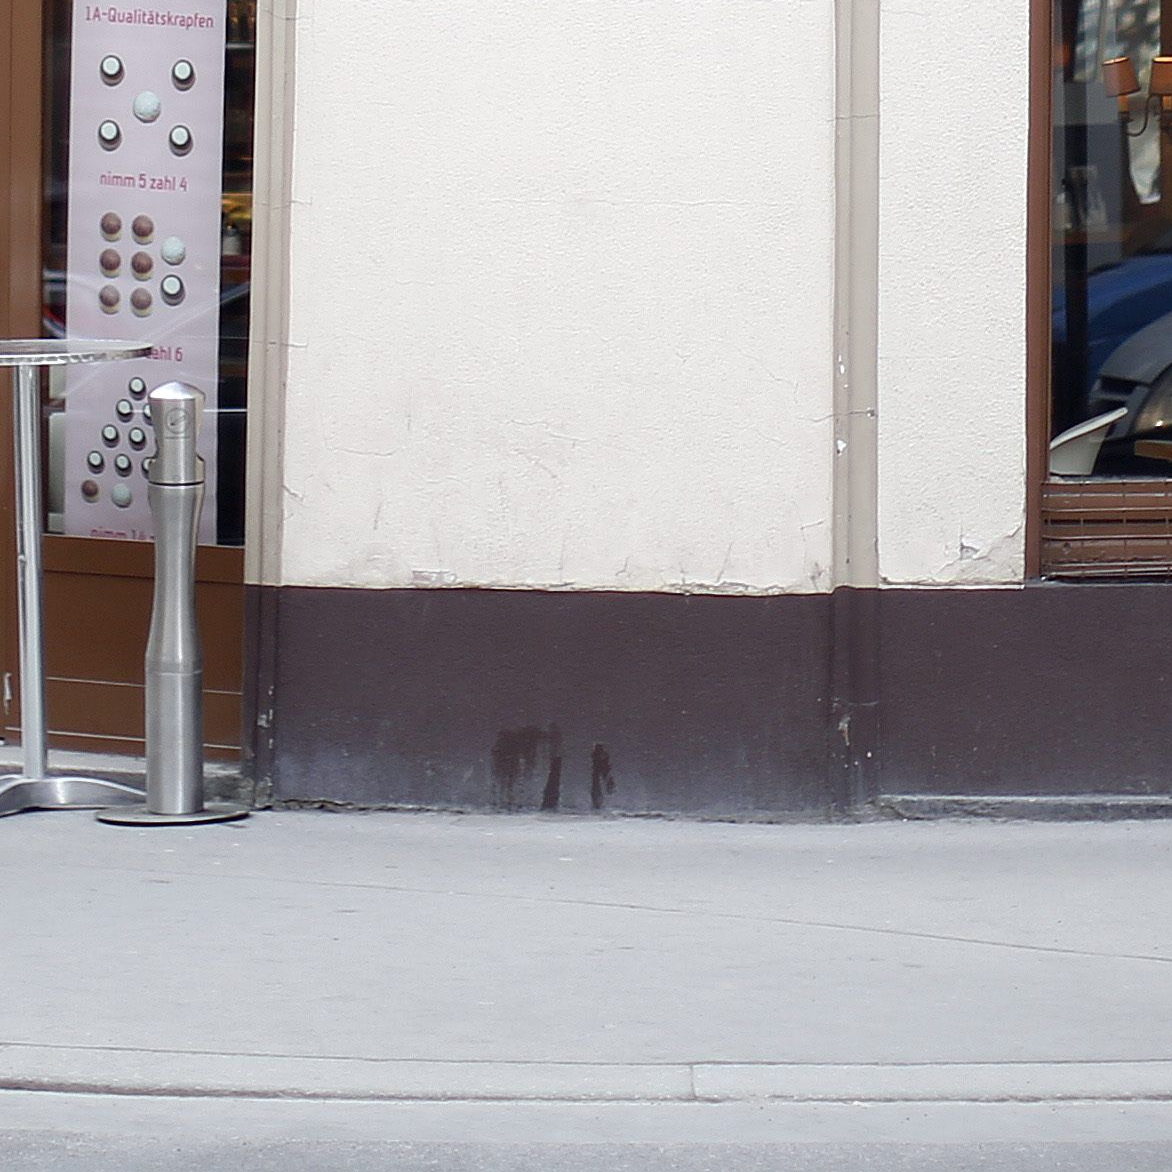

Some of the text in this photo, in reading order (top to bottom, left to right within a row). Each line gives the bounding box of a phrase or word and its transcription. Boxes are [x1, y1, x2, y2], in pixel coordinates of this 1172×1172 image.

[86, 5, 214, 30] 1A-Qualitätskrapfen
[100, 171, 188, 192] nimm 5 zahl 4
[174, 347, 183, 362] 6
